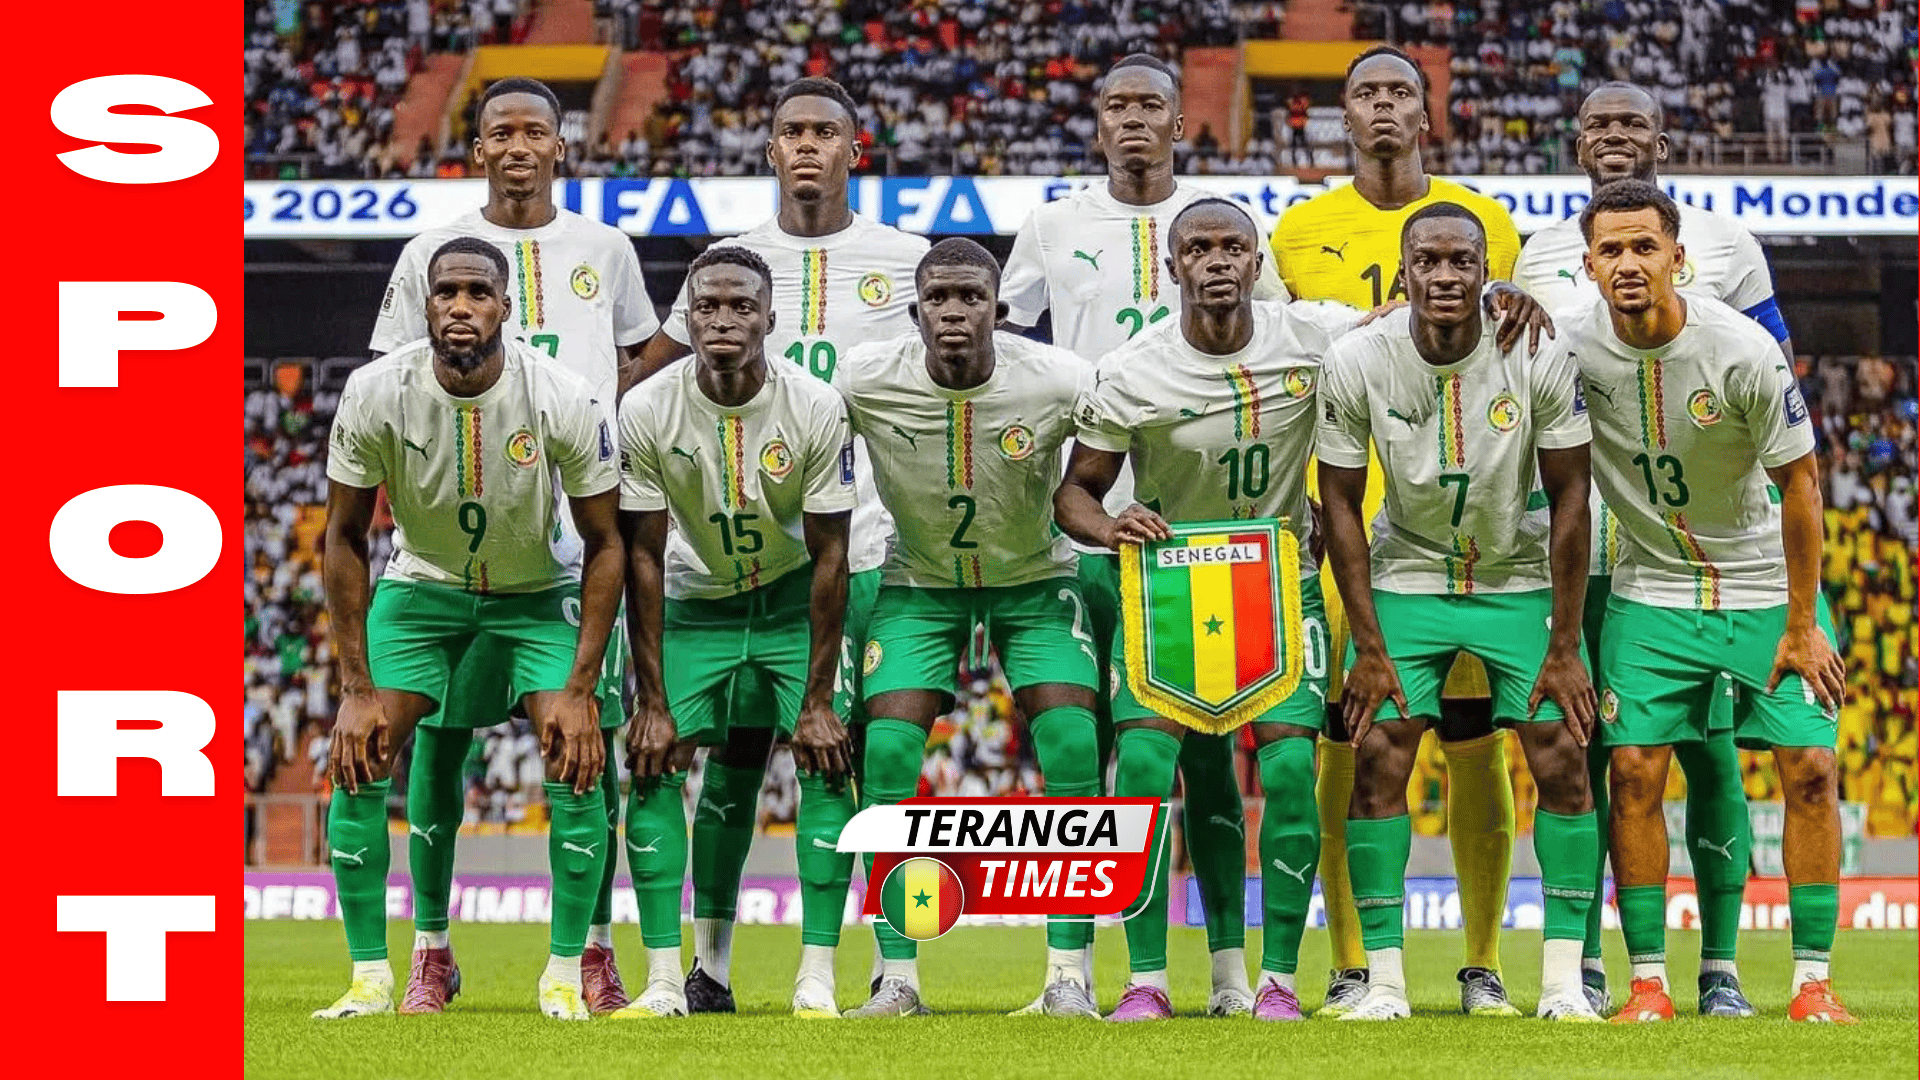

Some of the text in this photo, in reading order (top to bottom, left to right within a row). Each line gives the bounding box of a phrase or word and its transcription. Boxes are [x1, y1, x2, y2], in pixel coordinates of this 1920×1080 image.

[271, 188, 417, 220] 2026
[1735, 185, 1919, 216] Monde
[1218, 443, 1270, 500] 10
[1632, 453, 1689, 508] 13
[948, 495, 978, 549] 2
[1439, 474, 1470, 527] 7
[458, 502, 487, 553] 9
[709, 512, 763, 555] 15
[1162, 547, 1254, 564] SENEGAL
[1058, 588, 1092, 642] 2
